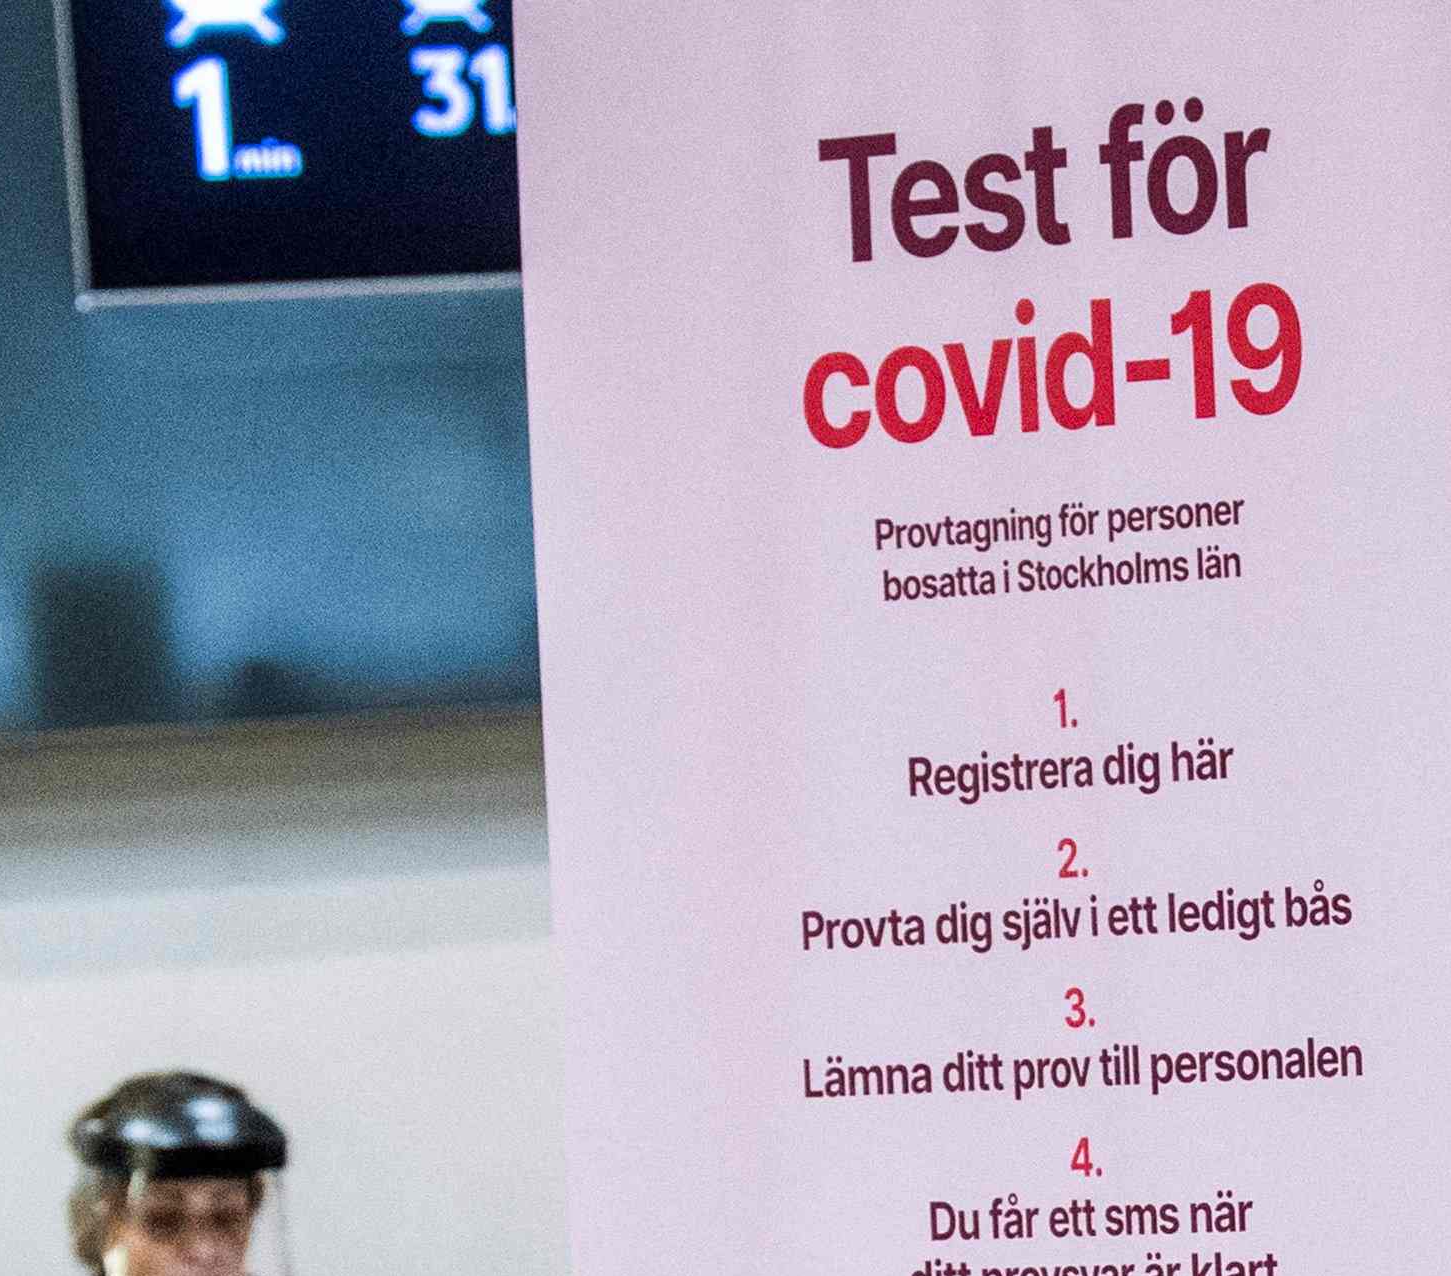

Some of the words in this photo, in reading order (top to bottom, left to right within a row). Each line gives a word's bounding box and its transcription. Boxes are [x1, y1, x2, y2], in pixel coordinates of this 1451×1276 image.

[173, 55, 232, 180] 1
[819, 126, 1071, 262] Test
[1099, 97, 1270, 239] för
[804, 283, 1302, 449] covid-19
[875, 508, 1052, 552] Provtagning
[1058, 503, 1099, 537] för
[1108, 500, 1244, 542] personer
[883, 566, 996, 601] bosatta
[1003, 560, 1010, 593] i
[1018, 552, 1189, 592] Stockholms
[1197, 545, 1241, 579] län
[1054, 689, 1078, 728] 1.
[909, 751, 1093, 805] Registrera
[1103, 742, 1160, 794] dig
[1171, 738, 1233, 781] här
[1058, 838, 1088, 878] 2.
[802, 910, 925, 950] Provta
[936, 902, 992, 953] dig
[1003, 898, 1081, 950] själv
[1090, 895, 1098, 936] i
[1108, 897, 1158, 936] ett
[1168, 888, 1275, 940] ledigt
[1285, 880, 1352, 927] bås
[1065, 988, 1095, 1028] 3.
[804, 1056, 932, 1098] Lämna
[943, 1050, 1004, 1092] ditt
[1014, 1057, 1090, 1100] prov
[1099, 1044, 1140, 1086] till
[1151, 1038, 1362, 1095] personalen
[1071, 1137, 1102, 1176] 4.
[930, 1201, 980, 1241] Du
[989, 1193, 1039, 1239] får
[1049, 1200, 1096, 1238] ett
[1106, 1204, 1179, 1236] sms
[1190, 1191, 1253, 1233] när
